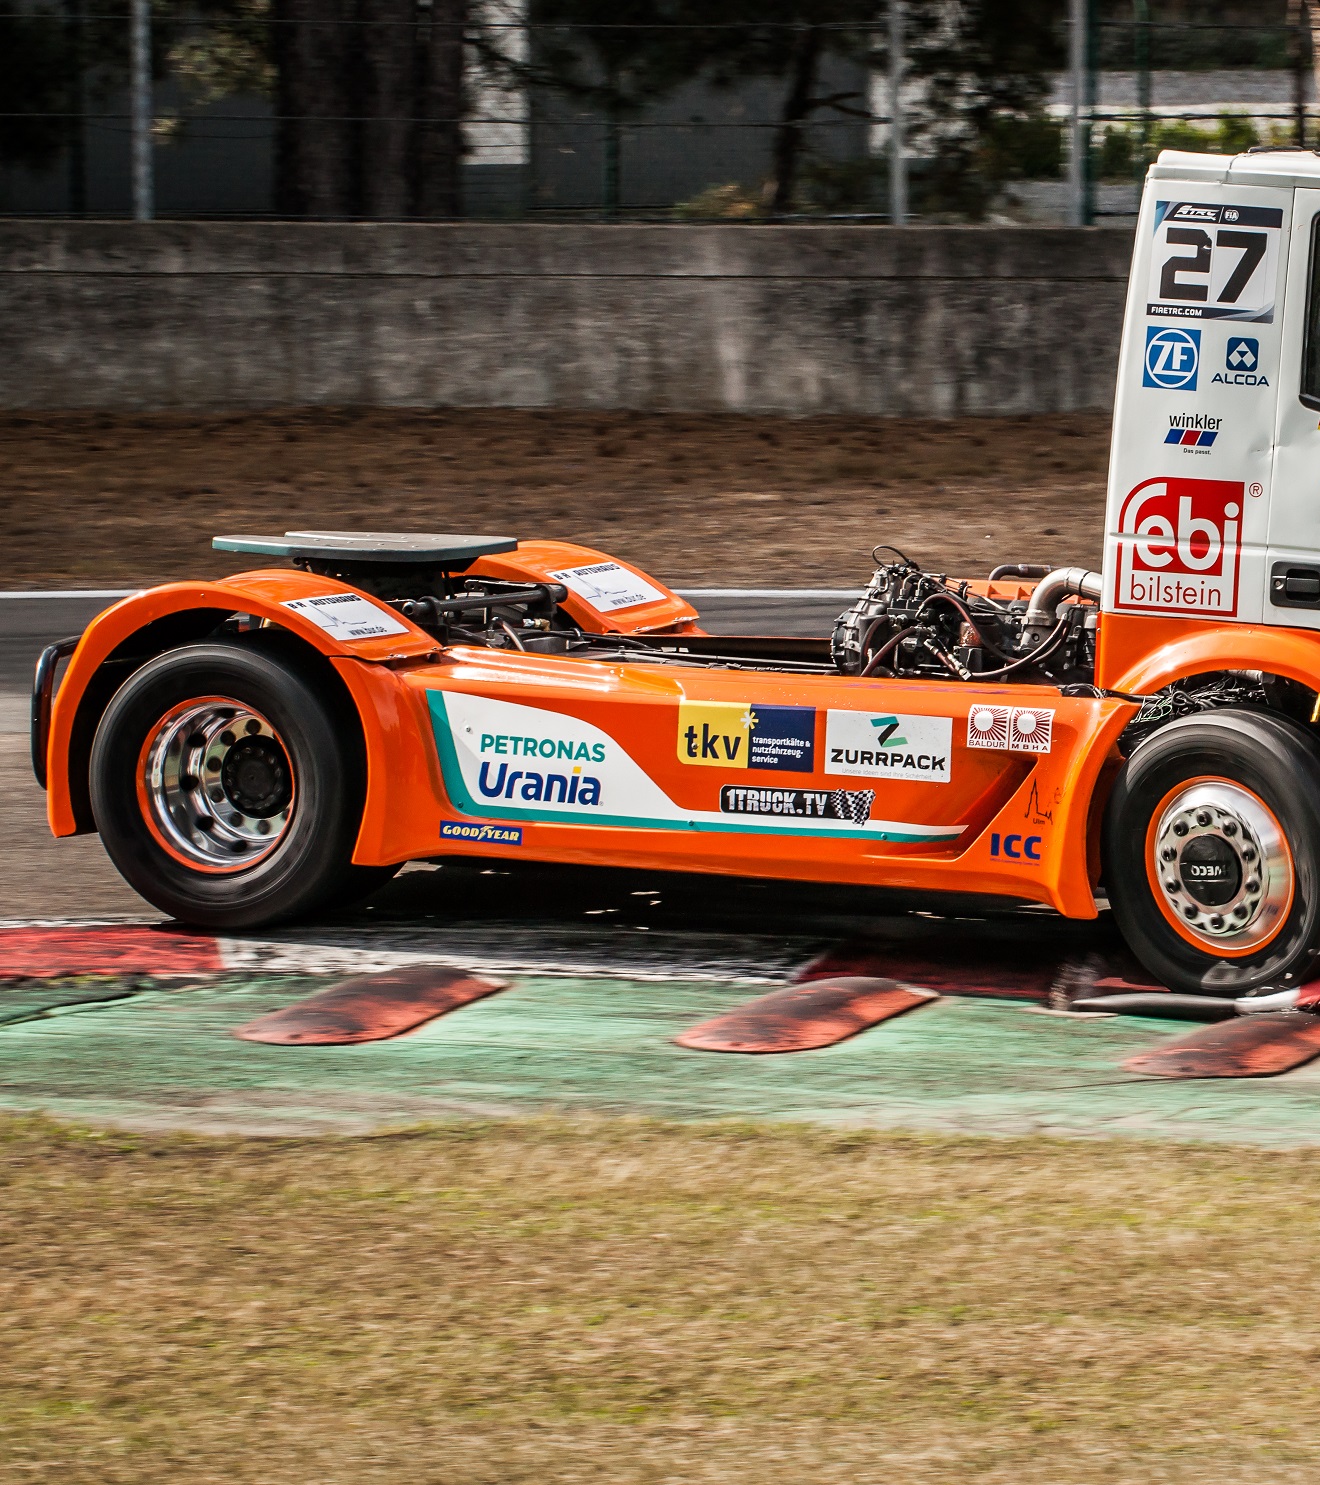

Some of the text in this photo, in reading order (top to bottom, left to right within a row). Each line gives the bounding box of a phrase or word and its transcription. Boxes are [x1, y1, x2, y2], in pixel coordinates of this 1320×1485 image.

[1160, 227, 1267, 303] 27
[1211, 373, 1269, 387] ALCOA
[1169, 413, 1223, 430] winkler
[1119, 482, 1240, 572] febi
[1130, 574, 1222, 607] bilstein
[480, 734, 606, 763] PETRONAS
[684, 723, 741, 762] tkv
[752, 736, 811, 748] transportkälte &
[752, 746, 804, 758] nutzfahrzeug-
[968, 740, 1006, 748] BALDUR
[751, 756, 779, 764] service
[830, 748, 946, 771] ZURRPACK
[478, 761, 602, 806] Urania
[727, 788, 828, 816] 1TRUCK.TV
[443, 825, 520, 841] GOODYEAR
[990, 833, 1042, 860] ICC
